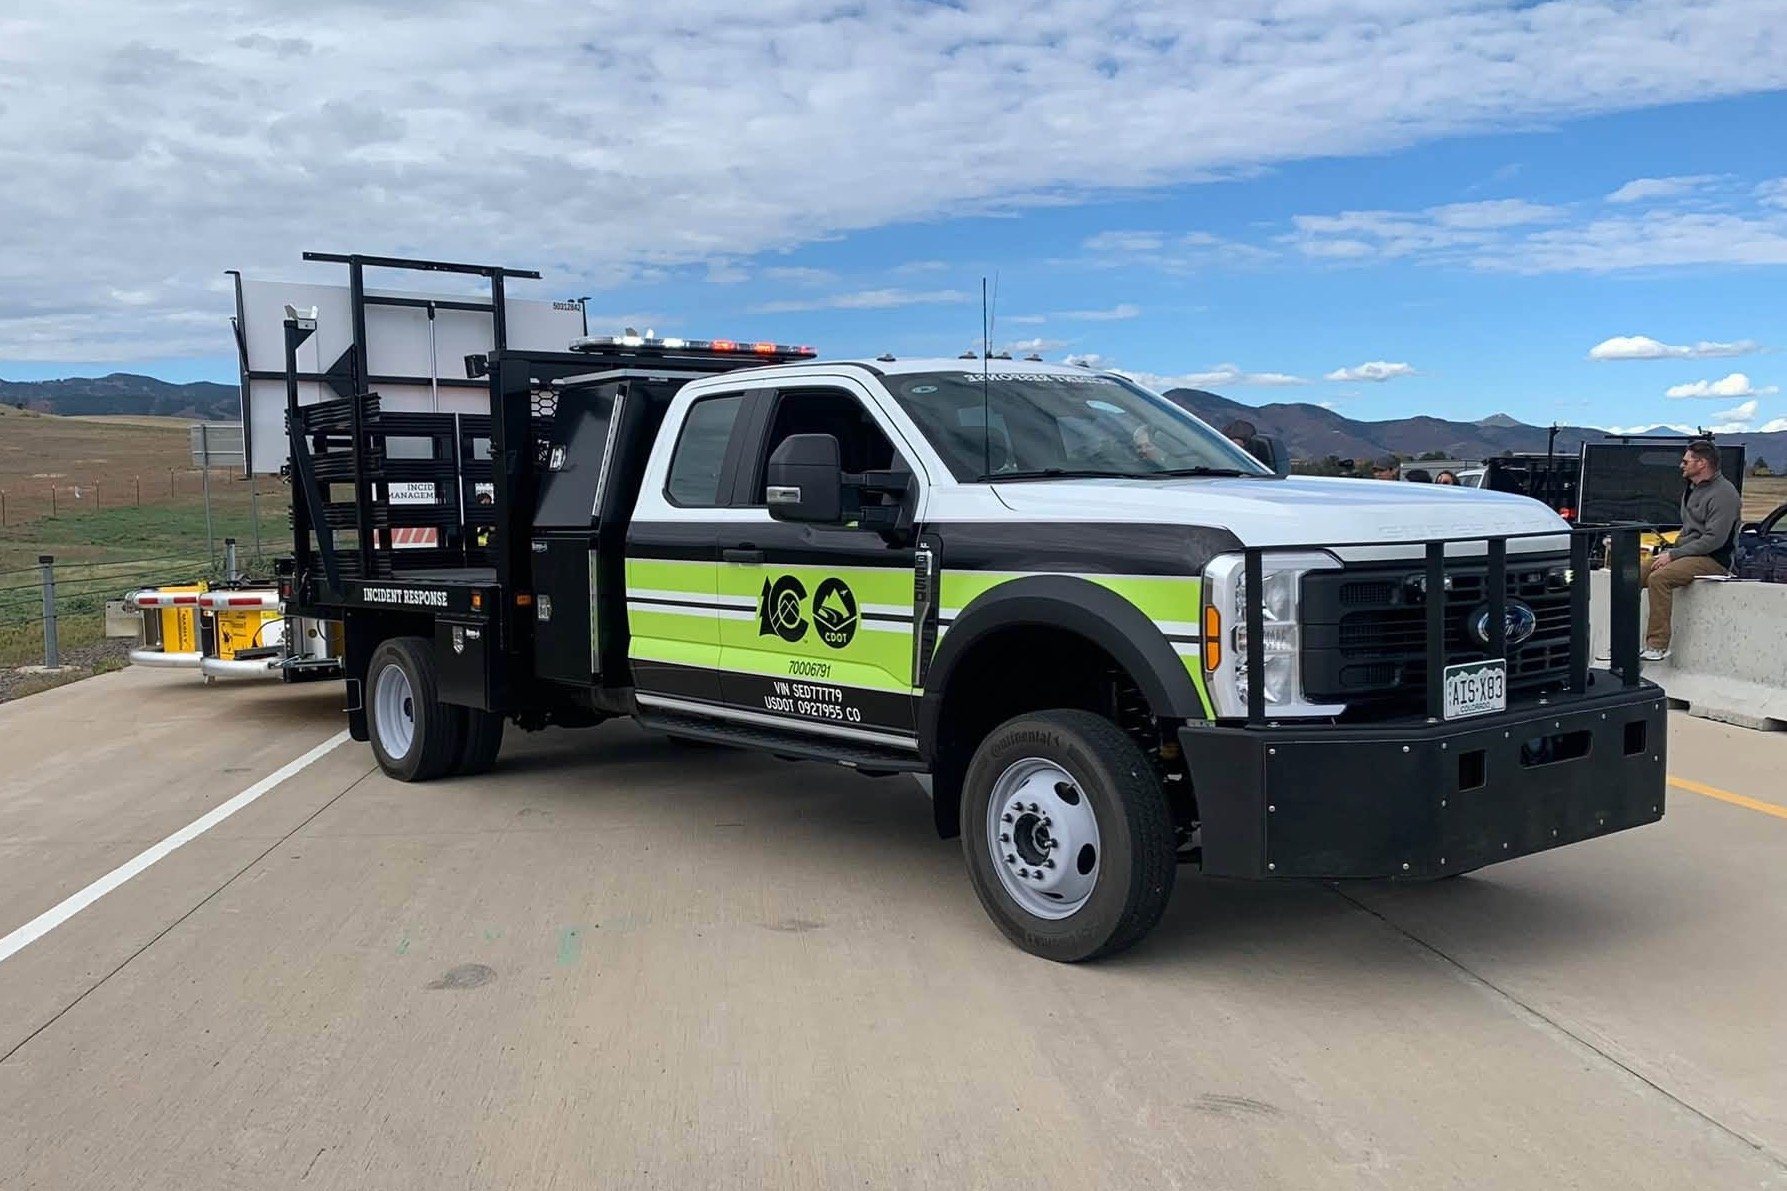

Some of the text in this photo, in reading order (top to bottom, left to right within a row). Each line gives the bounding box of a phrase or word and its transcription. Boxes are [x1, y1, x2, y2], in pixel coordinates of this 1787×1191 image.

[363, 588, 448, 606] INCIDENT RESPONSE
[825, 632, 847, 643] CDOT
[789, 661, 832, 678] 70006791
[773, 681, 790, 697] VIN
[764, 696, 861, 722] USDOT 0927955 CO
